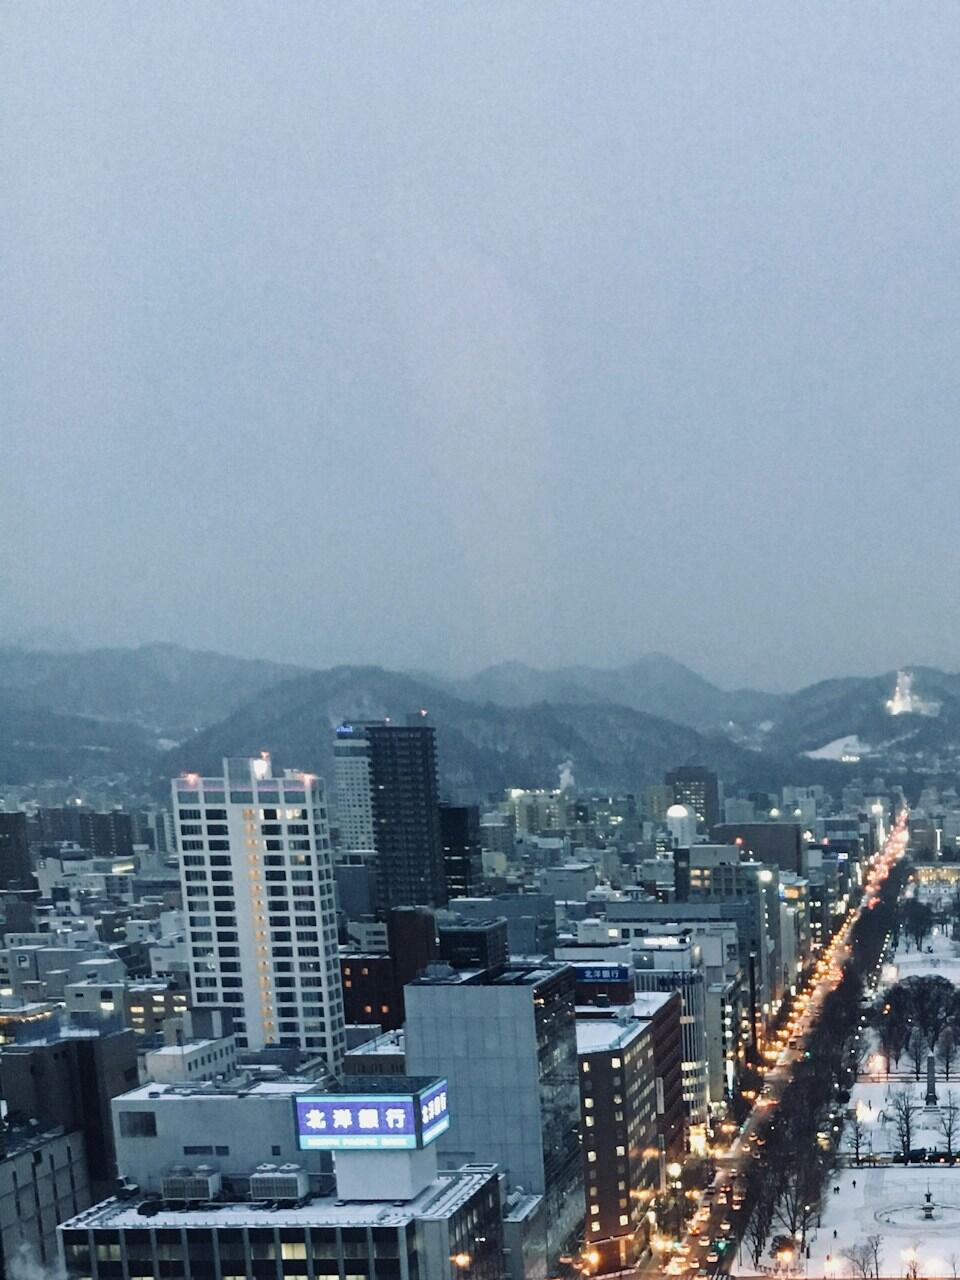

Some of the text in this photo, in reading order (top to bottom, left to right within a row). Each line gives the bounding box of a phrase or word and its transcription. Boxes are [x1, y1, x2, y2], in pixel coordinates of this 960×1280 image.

[18, 955, 28, 966] P
[305, 1108, 406, 1129] 北洋銀行
